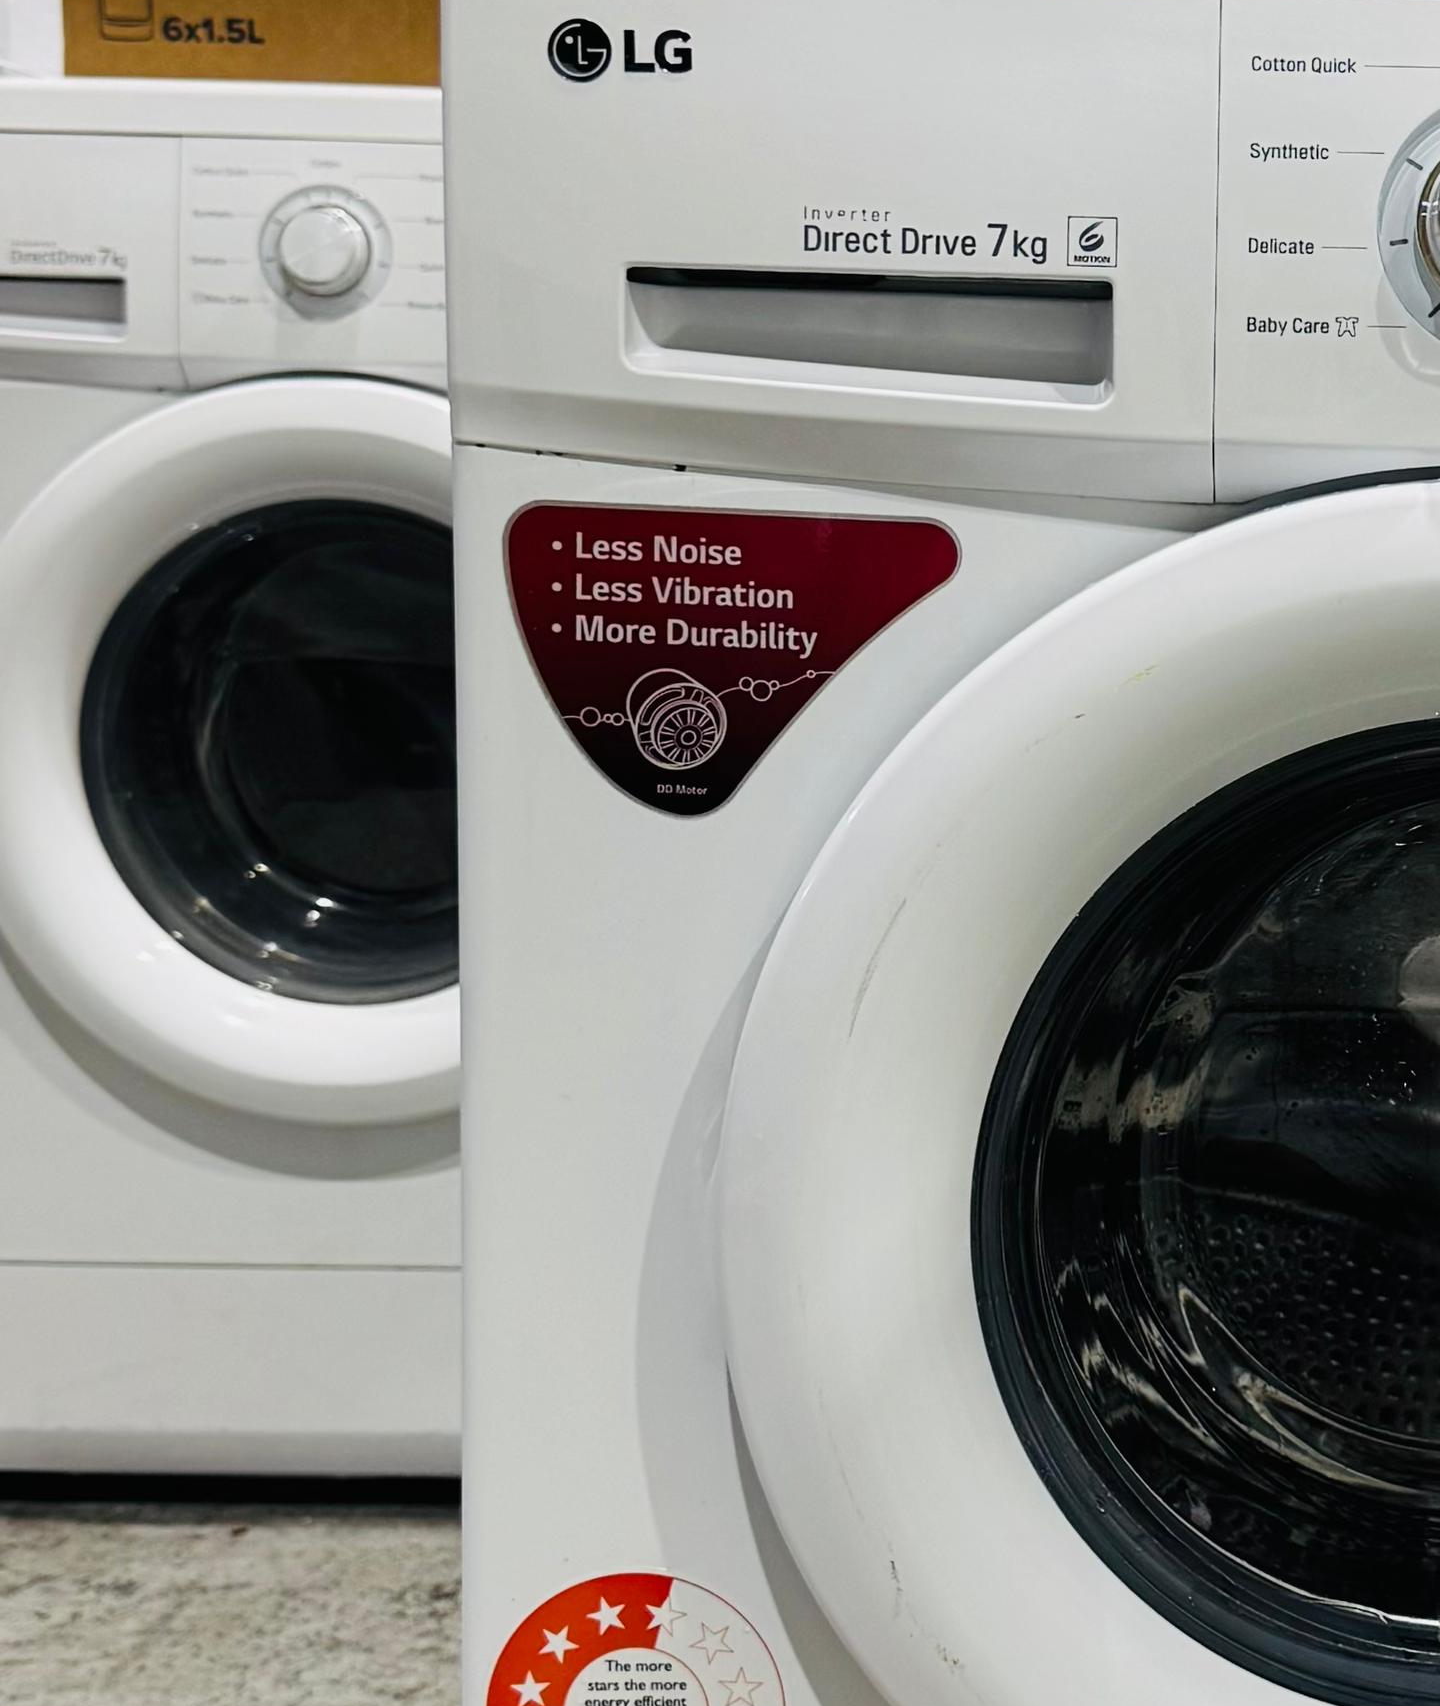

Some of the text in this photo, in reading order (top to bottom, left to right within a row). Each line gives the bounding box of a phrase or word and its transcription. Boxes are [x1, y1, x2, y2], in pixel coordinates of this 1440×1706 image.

[161, 16, 265, 46] 6x1.5L
[623, 29, 693, 74] LG
[1250, 55, 1357, 75] Cotton Quick
[1249, 143, 1330, 163] Synthetic
[804, 205, 892, 222] Inverter
[803, 224, 892, 254] Direct
[901, 227, 977, 257] Drive
[1247, 237, 1315, 255] Delicate
[1246, 316, 1330, 338] Baby Care
[575, 532, 742, 566] Less Noise
[575, 573, 794, 610] Less Vibration
[574, 614, 818, 659] More Durability
[656, 784, 708, 795] DD Motor
[605, 1660, 673, 1673] The more
[587, 1679, 687, 1691] stars the more
